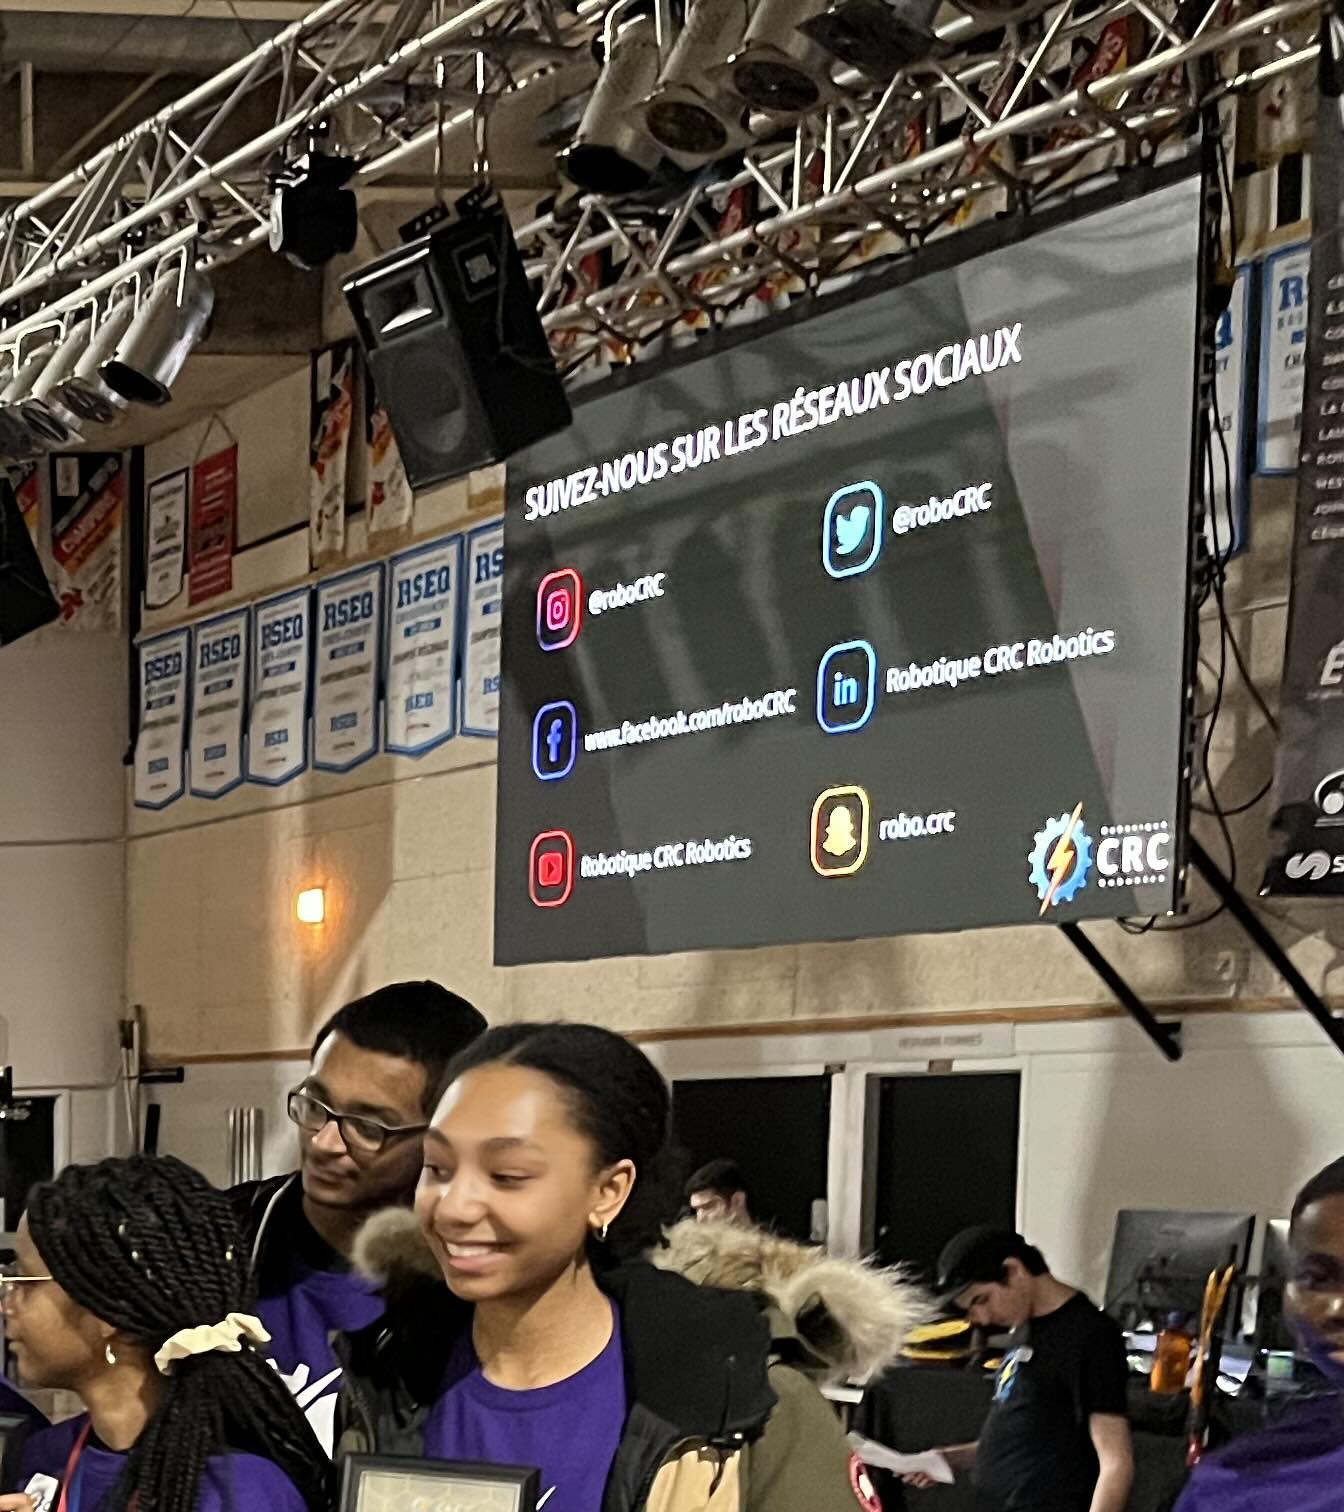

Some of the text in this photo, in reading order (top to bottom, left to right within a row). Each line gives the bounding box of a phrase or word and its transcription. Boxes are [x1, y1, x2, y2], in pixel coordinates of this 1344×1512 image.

[524, 322, 1023, 521] SUIVEZ-NOUS SUR LES RÉSEAUX SOCIAUX
[892, 482, 993, 535] @roboCRC
[588, 572, 666, 616] @roboCRC
[885, 626, 1116, 693] Robotique CRC Robotics
[584, 688, 797, 751] www.facebook.com/roboCRC
[878, 811, 957, 841] robo.crc
[580, 834, 752, 878] Robotique CRC Robotics
[1096, 832, 1170, 877] CRC
